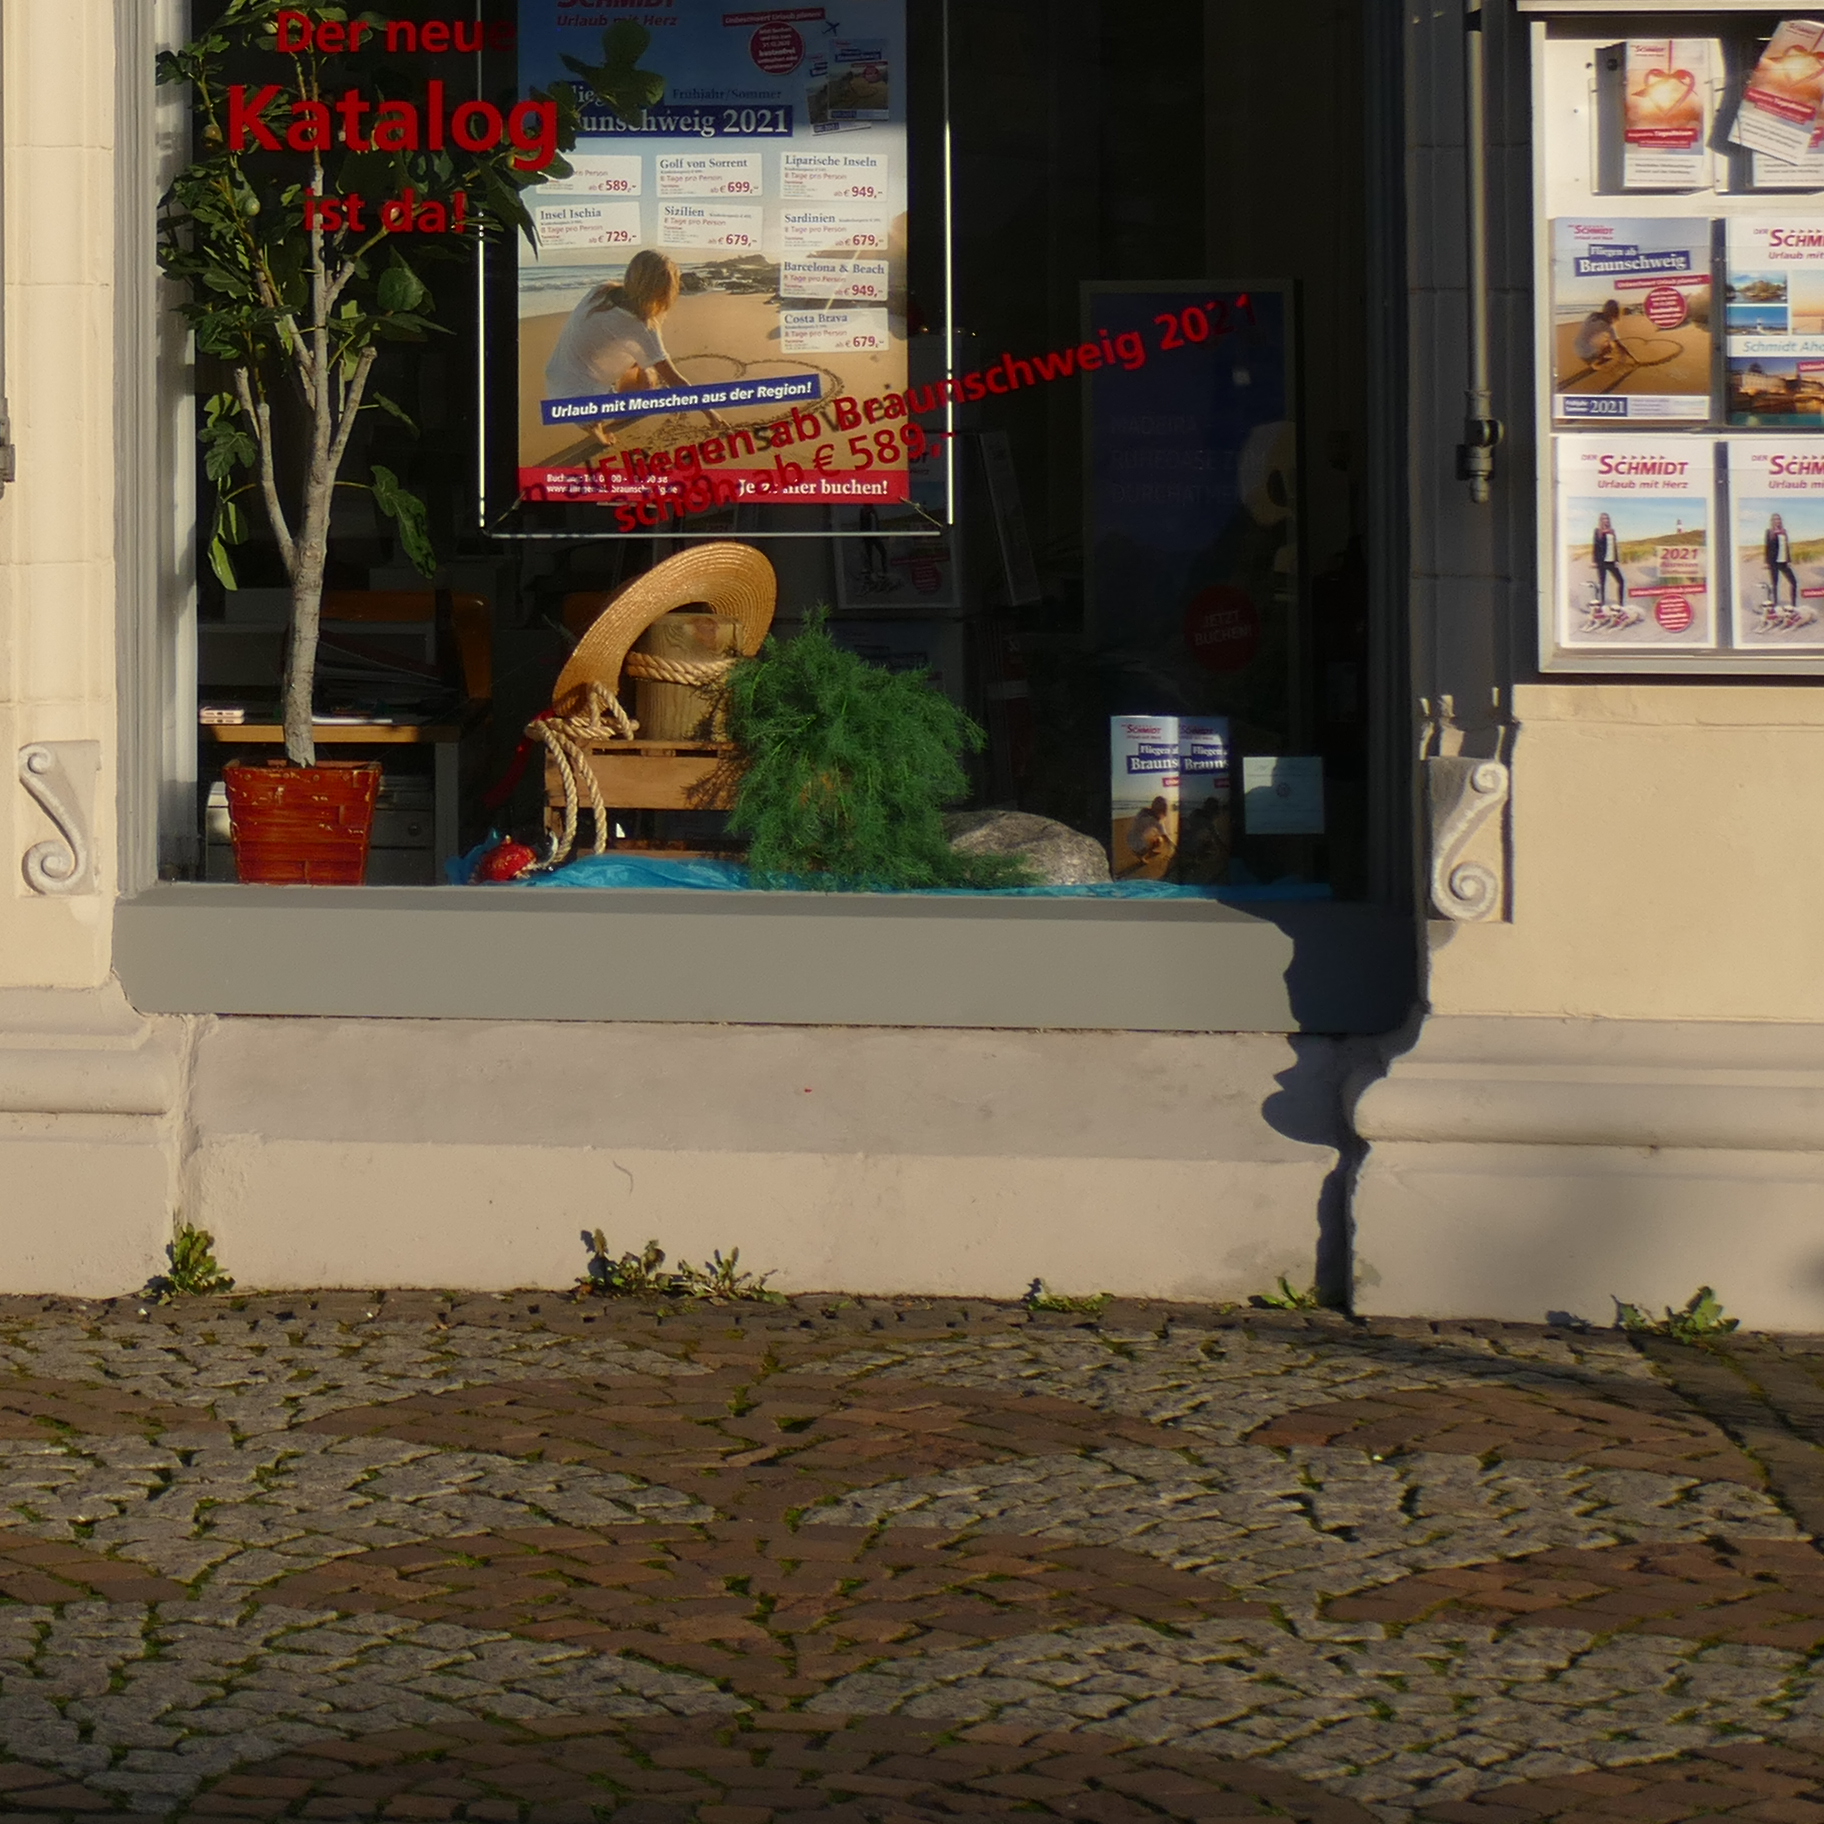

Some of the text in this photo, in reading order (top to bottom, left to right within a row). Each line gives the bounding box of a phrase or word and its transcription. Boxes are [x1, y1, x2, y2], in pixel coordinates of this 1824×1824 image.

[557, 15, 607, 26] Urlaub
[643, 14, 677, 26] Herz
[276, 10, 516, 53] Der neue
[228, 79, 557, 172] Katalog
[723, 109, 789, 134] 2021
[660, 158, 748, 169] Golf von Sorrent
[785, 155, 877, 169] Liparische Inseln
[606, 180, 637, 192] 589,-
[727, 181, 759, 194] 699,-
[851, 186, 883, 199] 949,-
[304, 188, 467, 234] ist da!
[540, 207, 602, 220] Insel Ischia
[664, 206, 705, 217] Sizilien
[784, 213, 836, 224] Sardinien
[606, 231, 637, 243] 729,-
[726, 234, 758, 247] 679,-
[852, 234, 884, 248] 679,-
[1590, 245, 1637, 257] Fliegen ab
[1768, 251, 1803, 259] Urlaub
[784, 261, 885, 275] Barcelona & Beach
[1580, 254, 1687, 273] Braunschweig
[851, 284, 884, 298] 949,-
[785, 312, 848, 324] Costa Brava
[853, 336, 885, 349] 679,-
[1743, 341, 1798, 352] Schmidt
[599, 292, 1256, 486] Fliegen ab Braunschweig 2021
[551, 381, 812, 419] Urlaub mit Menschen aus der Region!
[1590, 400, 1625, 413] 2021
[754, 454, 803, 492] ab
[813, 443, 840, 477] €
[849, 421, 957, 472] 589,-
[1598, 455, 1689, 475] SCHMIDT
[821, 479, 888, 495] buchen!
[1598, 480, 1689, 489] Urlaub mit Herz
[1769, 480, 1807, 489] Urlaub
[1660, 548, 1699, 560] 2021
[1201, 609, 1240, 627] JETZT
[1140, 745, 1168, 755] Fliegen
